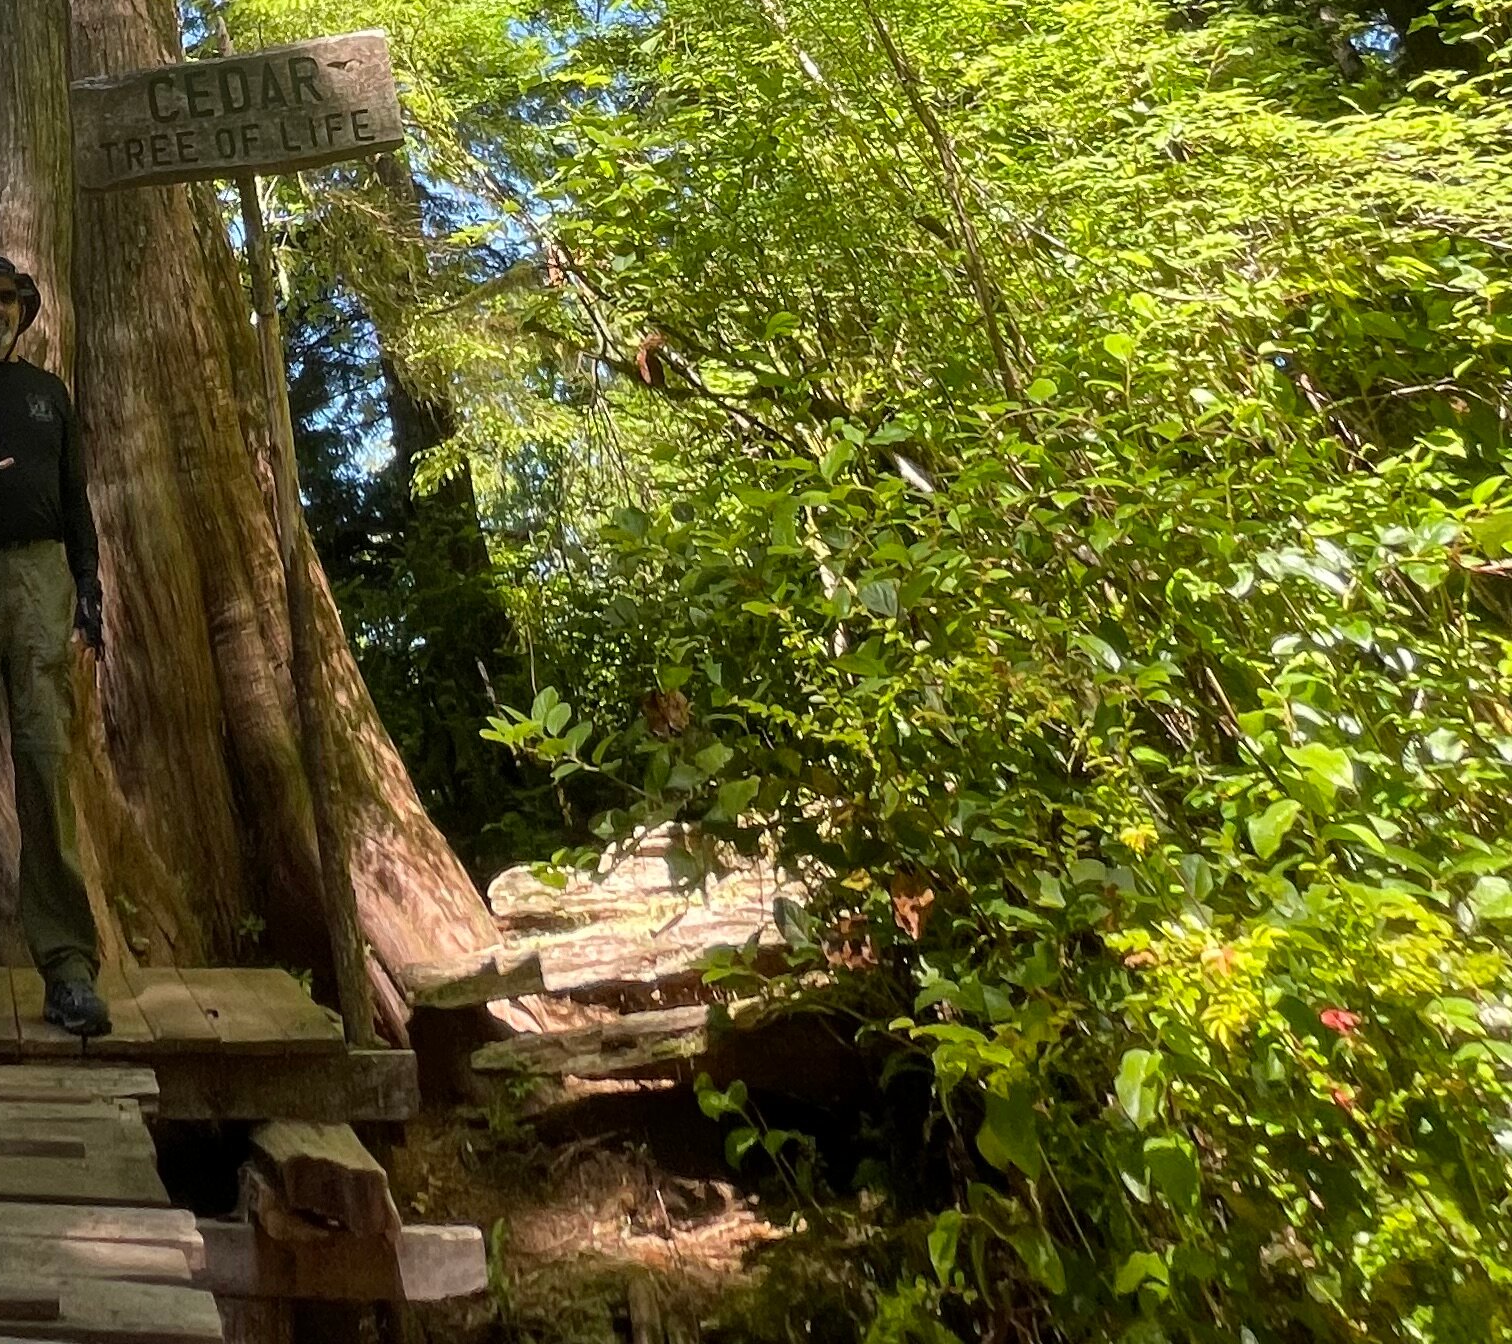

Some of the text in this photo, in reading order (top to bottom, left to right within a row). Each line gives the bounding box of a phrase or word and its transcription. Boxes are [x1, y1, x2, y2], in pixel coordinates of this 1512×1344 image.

[149, 56, 324, 123] CEDAR
[99, 109, 376, 174] TREE OF LIFE
